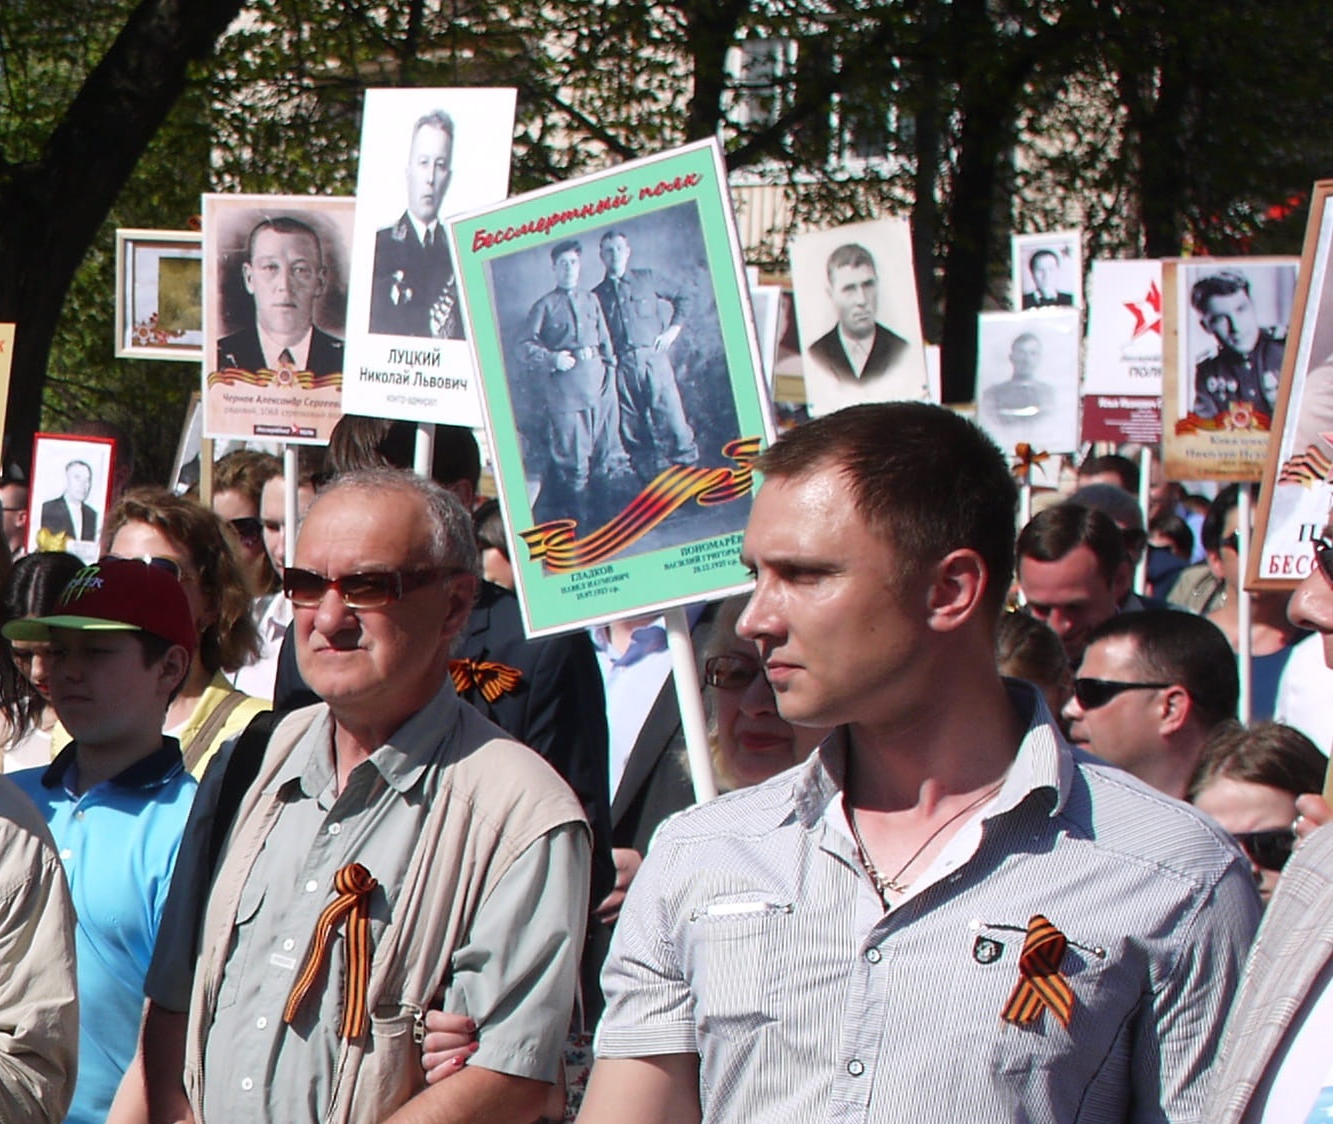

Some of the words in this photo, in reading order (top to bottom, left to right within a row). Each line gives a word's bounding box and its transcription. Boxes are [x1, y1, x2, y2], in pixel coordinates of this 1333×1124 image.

[387, 347, 441, 369] ЛУЦКИЙ
[359, 366, 410, 386] Николай
[412, 371, 468, 391] Львович
[304, 396, 341, 408] Сергеев
[570, 564, 614, 582] ГЛАДКОВ
